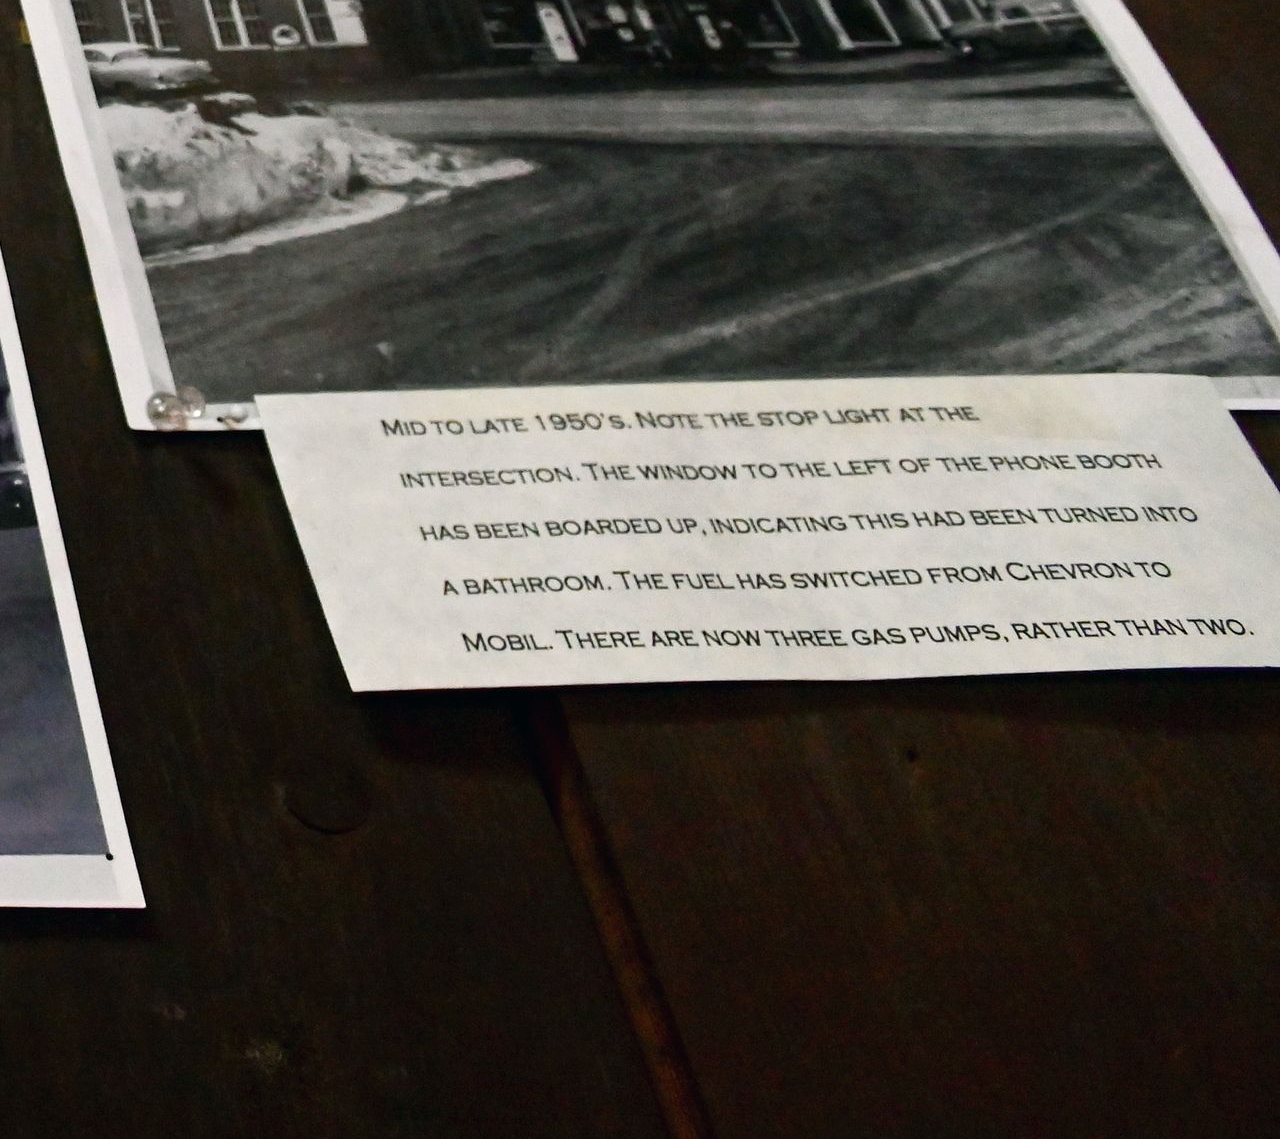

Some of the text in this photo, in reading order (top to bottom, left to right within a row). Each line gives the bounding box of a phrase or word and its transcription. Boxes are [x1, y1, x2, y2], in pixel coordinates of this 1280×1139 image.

[380, 405, 981, 437] MID TO LATE 1950'S. NOTE THE STOP LIGHT AT THE
[399, 452, 1163, 489] INTERSECTION. THE WINDOW TO THE LEFT OF THE PHONE BOOTH
[419, 506, 1199, 541] HAS BEEN BOARDED UP, INDICATING THIS HAD BEEN TURNED INTO
[443, 561, 1172, 596] A BATHROOM. THE FUEL HAS SWITCHED FROM CHEVRON TO
[461, 618, 1255, 653] MOBIL. THERE ARE NOW THREE GAS PUMPS, RATHER THAN TWO.
